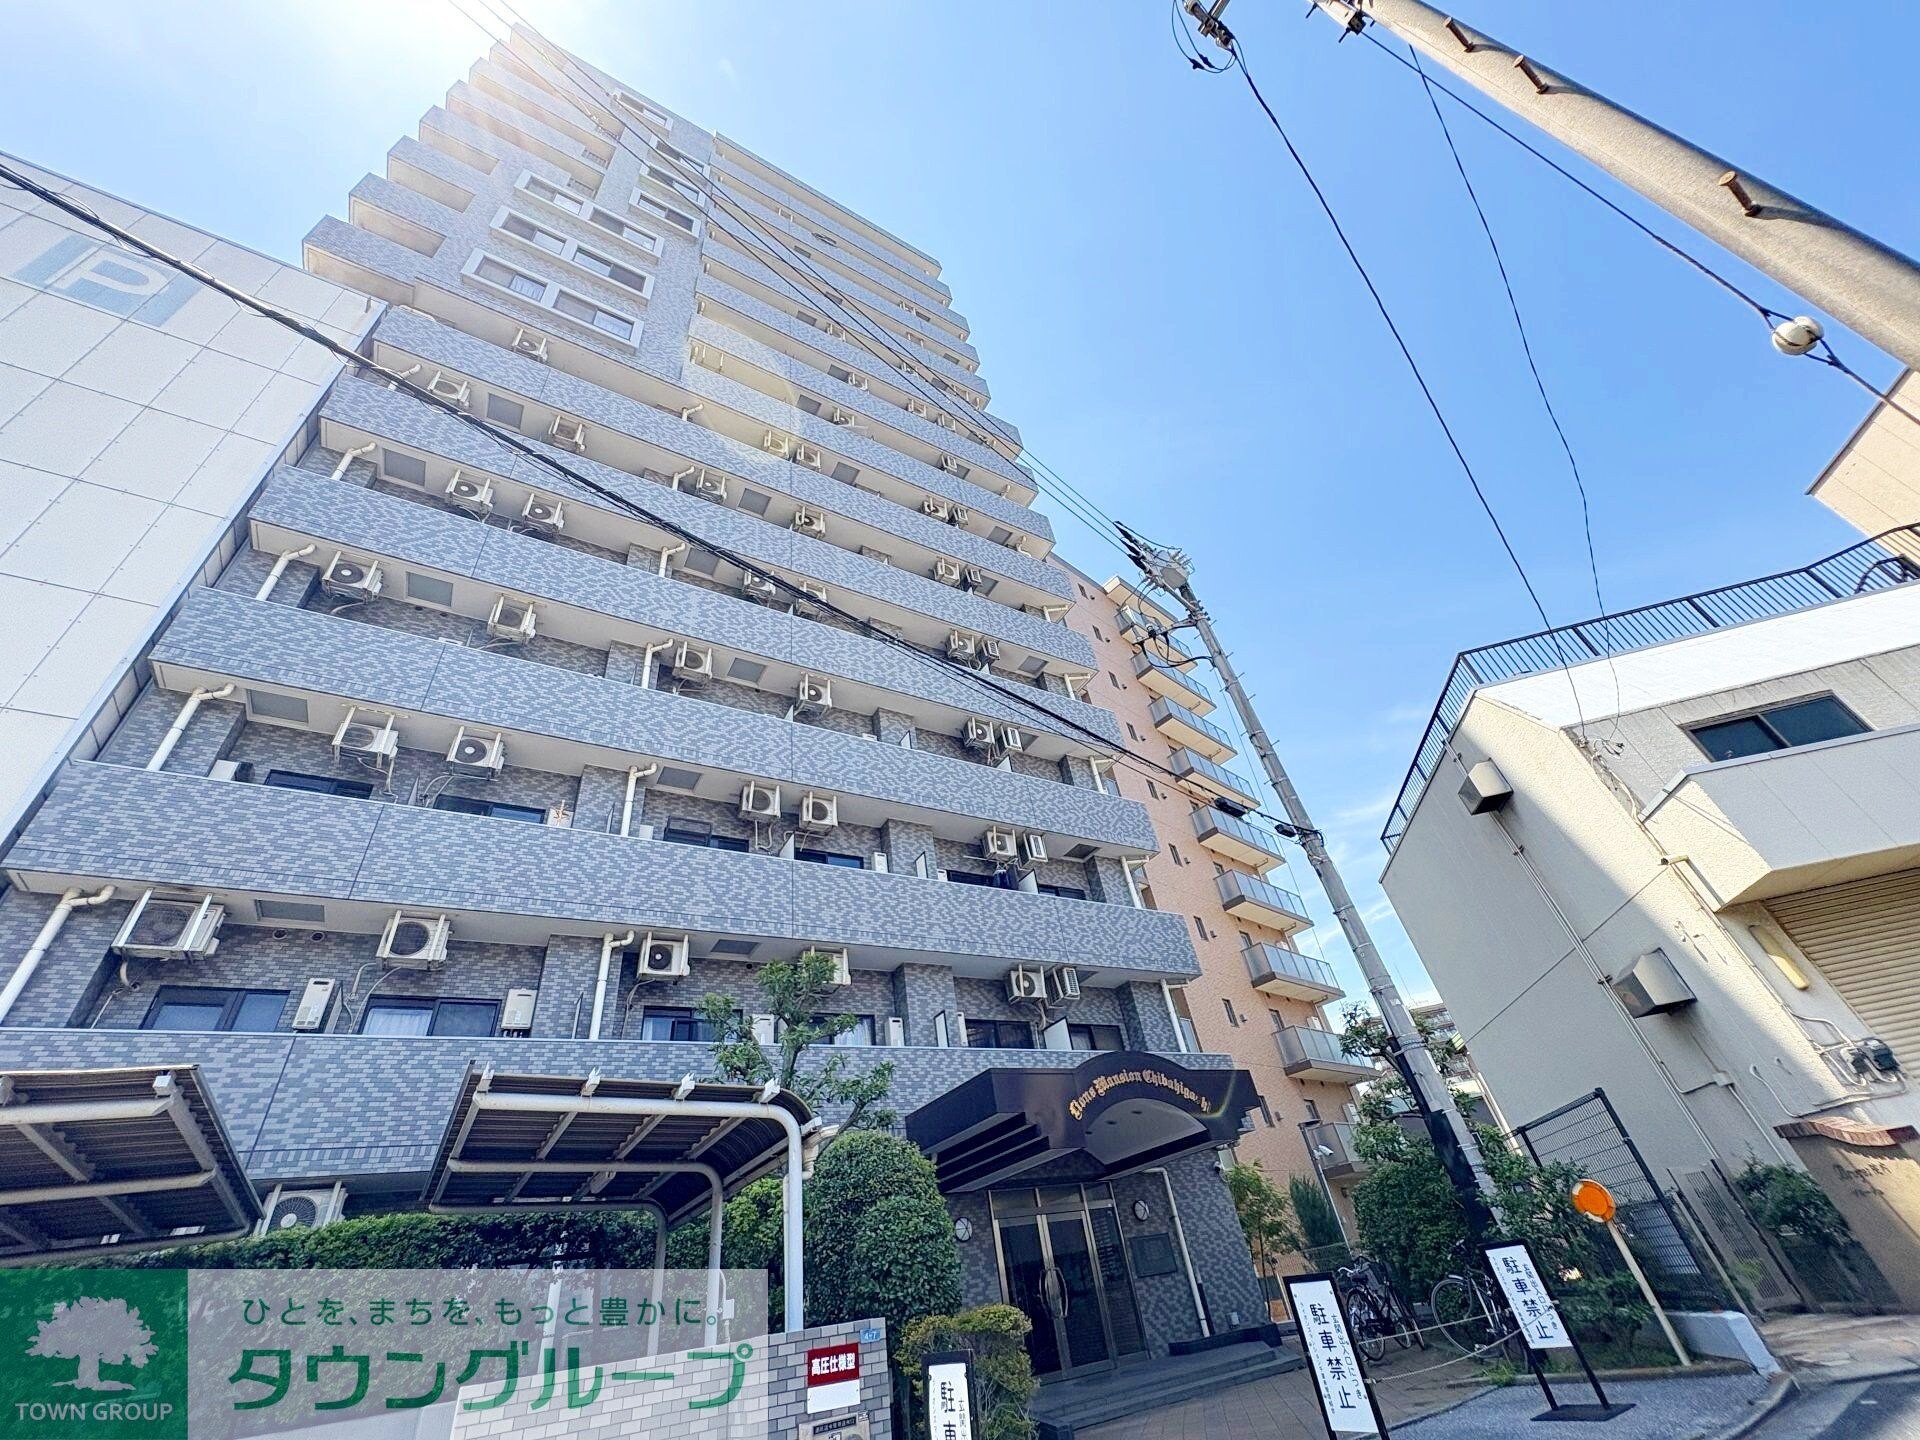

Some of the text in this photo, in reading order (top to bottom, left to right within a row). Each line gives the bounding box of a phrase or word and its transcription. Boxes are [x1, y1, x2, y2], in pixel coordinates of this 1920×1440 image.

[44, 245, 170, 297] P
[1070, 1087, 1097, 1120] Lions
[1093, 1069, 1142, 1096] Mansion
[1502, 1256, 1554, 1339] 駐車禁止
[811, 1352, 856, 1376] 高圧仕様型
[1310, 1303, 1356, 1409] 駐車禁止
[1331, 1313, 1362, 1400] 玄関出入口につき
